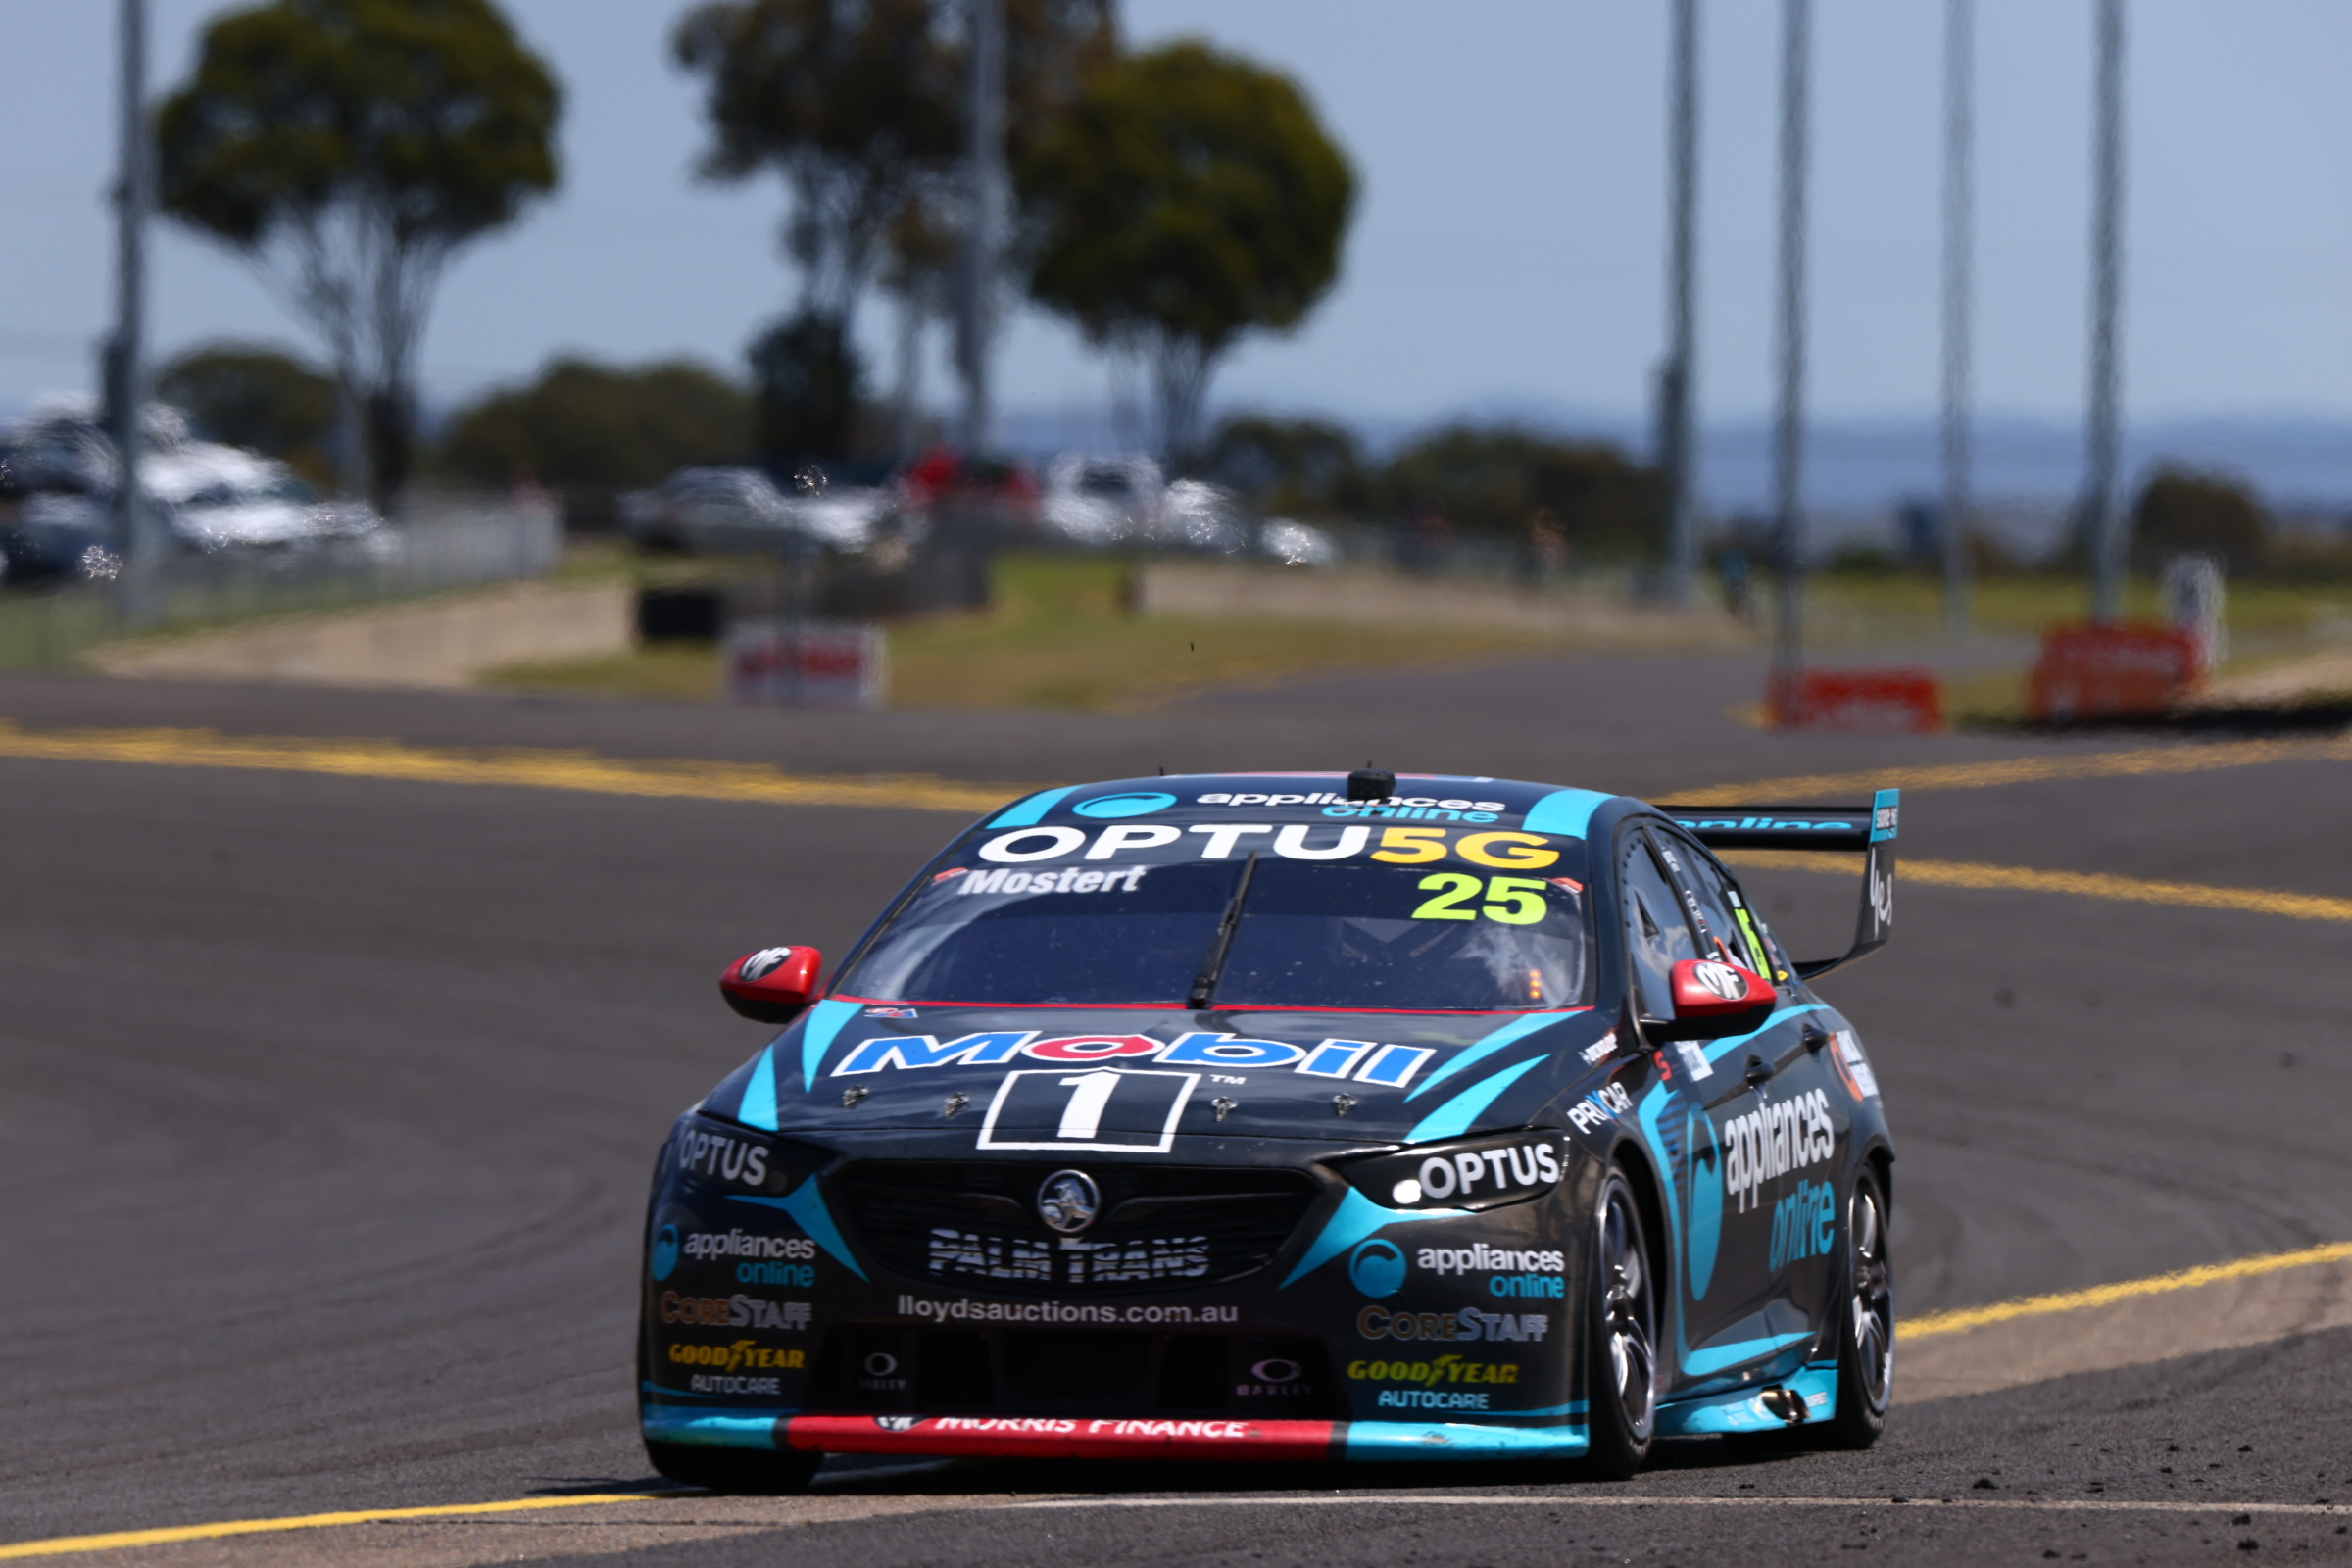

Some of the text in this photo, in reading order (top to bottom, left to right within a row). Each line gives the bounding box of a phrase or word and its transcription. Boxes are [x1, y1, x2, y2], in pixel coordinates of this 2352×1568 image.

[1321, 805, 1500, 824] online
[957, 865, 1148, 895] Mostert
[1410, 872, 1547, 925] 25
[831, 1031, 1436, 1088] Mobil
[1059, 1071, 1122, 1139] 1
[678, 1129, 769, 1186] OPTUS
[1725, 1088, 1835, 1214] appliances
[1419, 1144, 1560, 1199] OPTUS
[1770, 1179, 1836, 1273] online
[684, 1229, 816, 1261] appliances
[1417, 1243, 1565, 1275] appliances
[736, 1261, 816, 1288] online
[1489, 1274, 1565, 1298] online
[898, 1294, 1239, 1324] lloydsauctions.com.au
[668, 1340, 807, 1372] GOODYEAR
[1348, 1354, 1519, 1387] GOODYEAR
[690, 1374, 782, 1396] AUTOCARE
[1377, 1390, 1490, 1409] AUTOCARE
